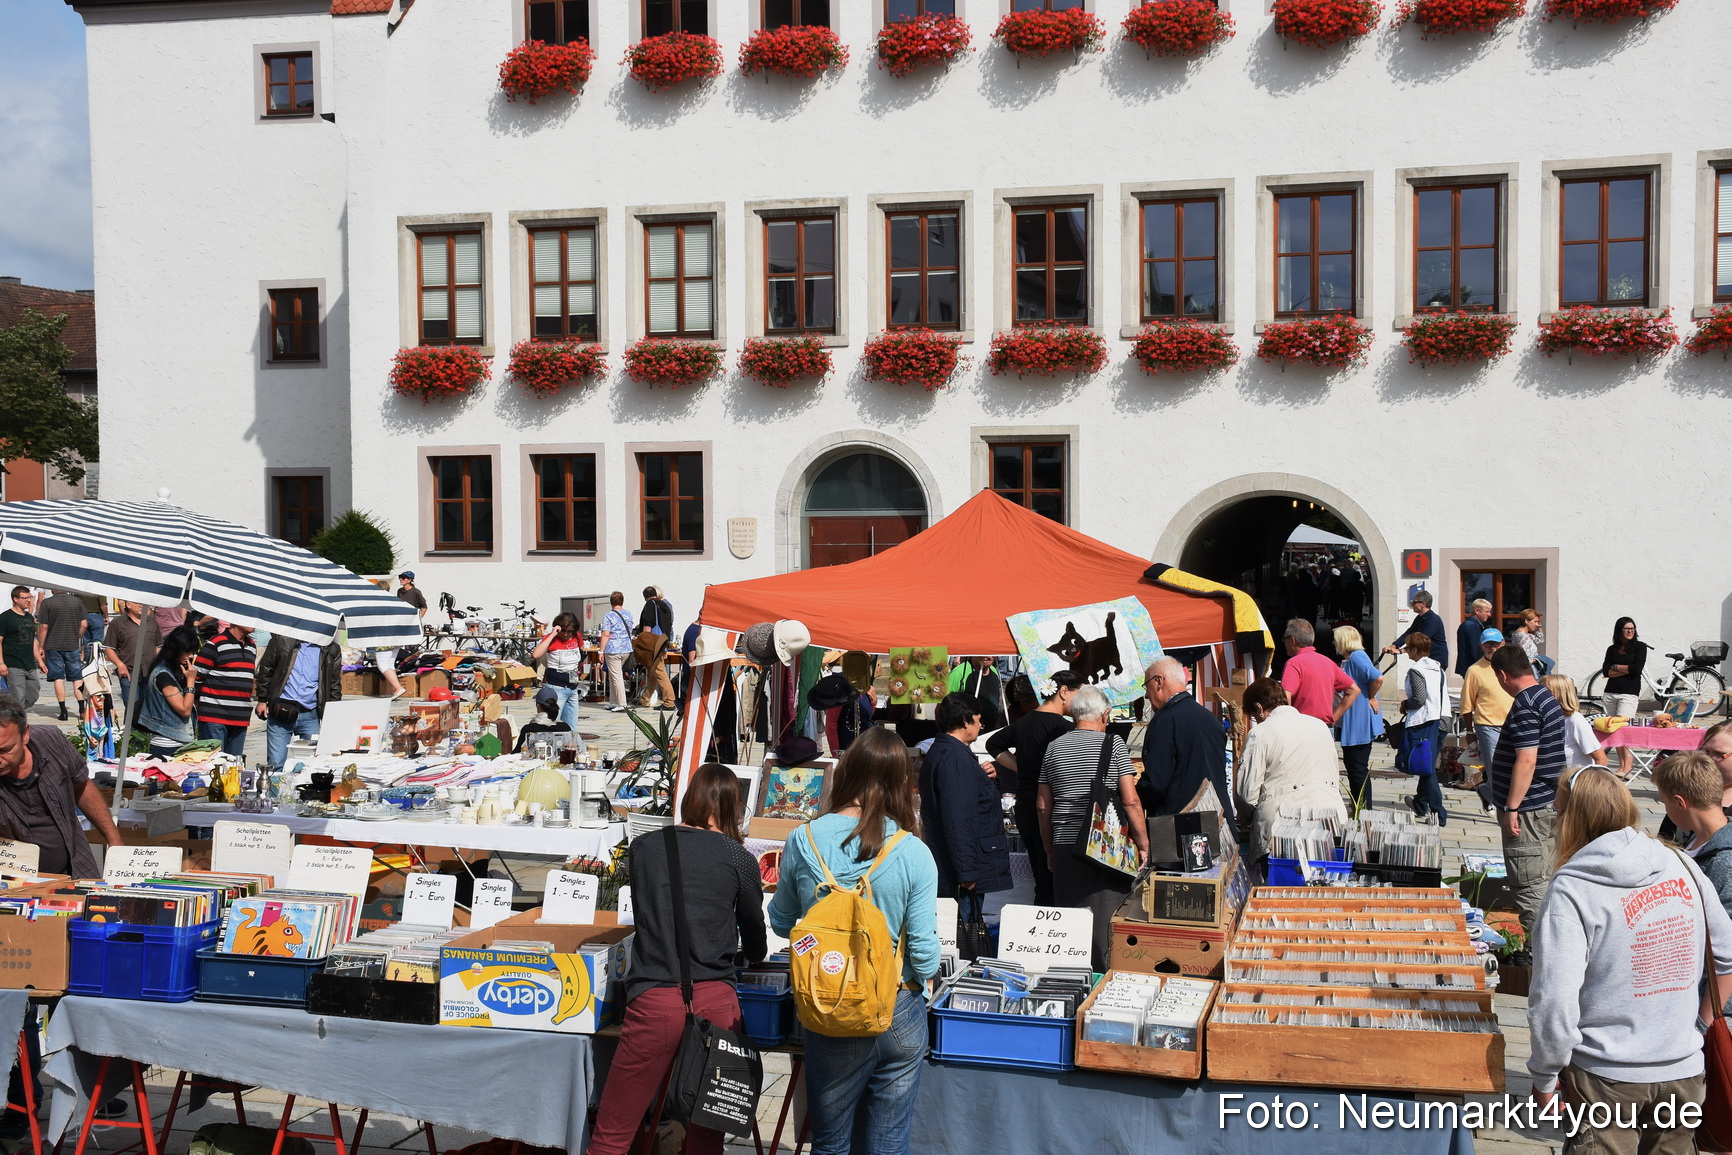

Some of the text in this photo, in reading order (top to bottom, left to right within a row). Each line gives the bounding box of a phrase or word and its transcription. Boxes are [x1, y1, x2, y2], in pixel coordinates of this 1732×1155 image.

[143, 860, 159, 868] Euro
[416, 877, 441, 887] Singles
[560, 874, 586, 886] Singles
[481, 882, 507, 892] Singles
[428, 892, 445, 902] Euro
[572, 890, 590, 900] Euro
[494, 897, 511, 907] Euro
[1624, 878, 1692, 925] HERZBERG
[1642, 903, 1654, 914] JULI
[1036, 910, 1061, 921] DVD
[1048, 929, 1067, 938] Euro
[1006, 942, 1014, 952] 3
[1016, 945, 1041, 953] Stück
[443, 949, 548, 964] PREMIUM BANANAS
[501, 970, 532, 978] QUALITY
[484, 980, 550, 1014] derby
[442, 1005, 480, 1013] COLOMBIA
[718, 1039, 757, 1061] BERLIN
